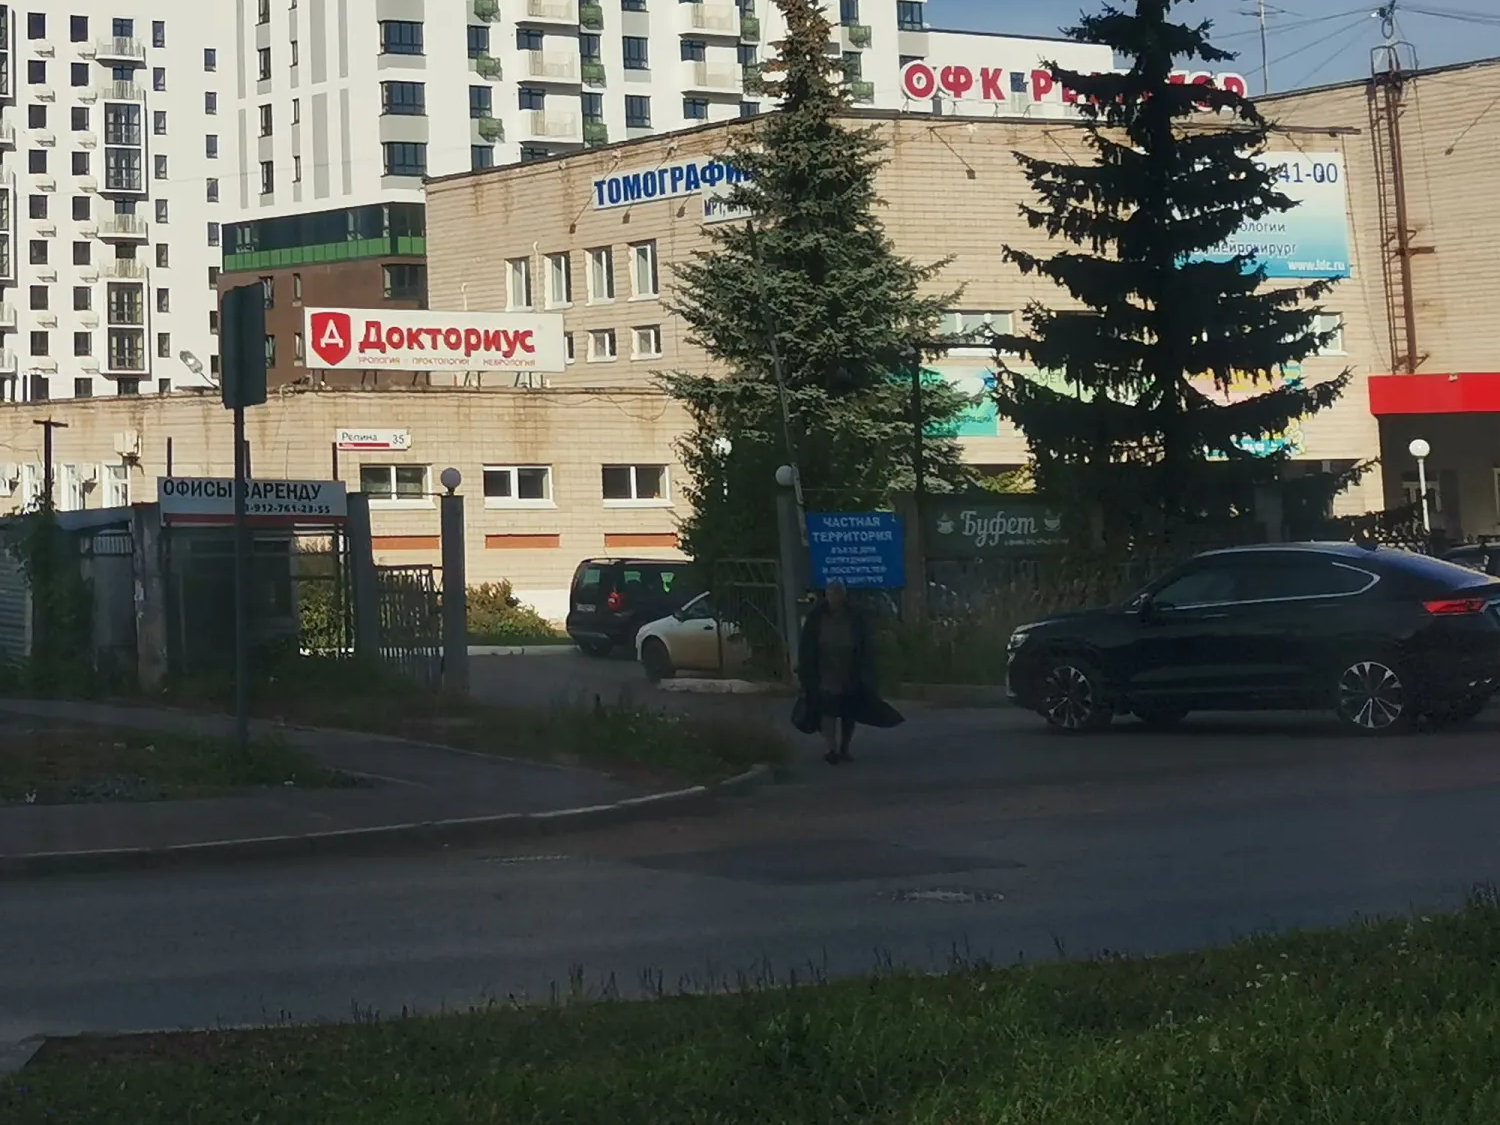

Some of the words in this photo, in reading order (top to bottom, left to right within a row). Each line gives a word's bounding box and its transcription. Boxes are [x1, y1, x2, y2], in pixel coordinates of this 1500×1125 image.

[904, 62, 1006, 102] ОФК
[593, 159, 756, 206] ТОМОГРАФИ
[1256, 161, 1338, 184] 41-00
[1241, 222, 1286, 232] ологии
[358, 320, 536, 358] Докториус
[342, 431, 378, 442] Репина
[392, 434, 405, 445] 35
[163, 478, 233, 498] ОФИСЫ
[822, 516, 881, 527] ЧАСТНАЯ
[960, 510, 1039, 548] Буфет
[811, 530, 893, 543] ТЕРРИТОРИЯ
